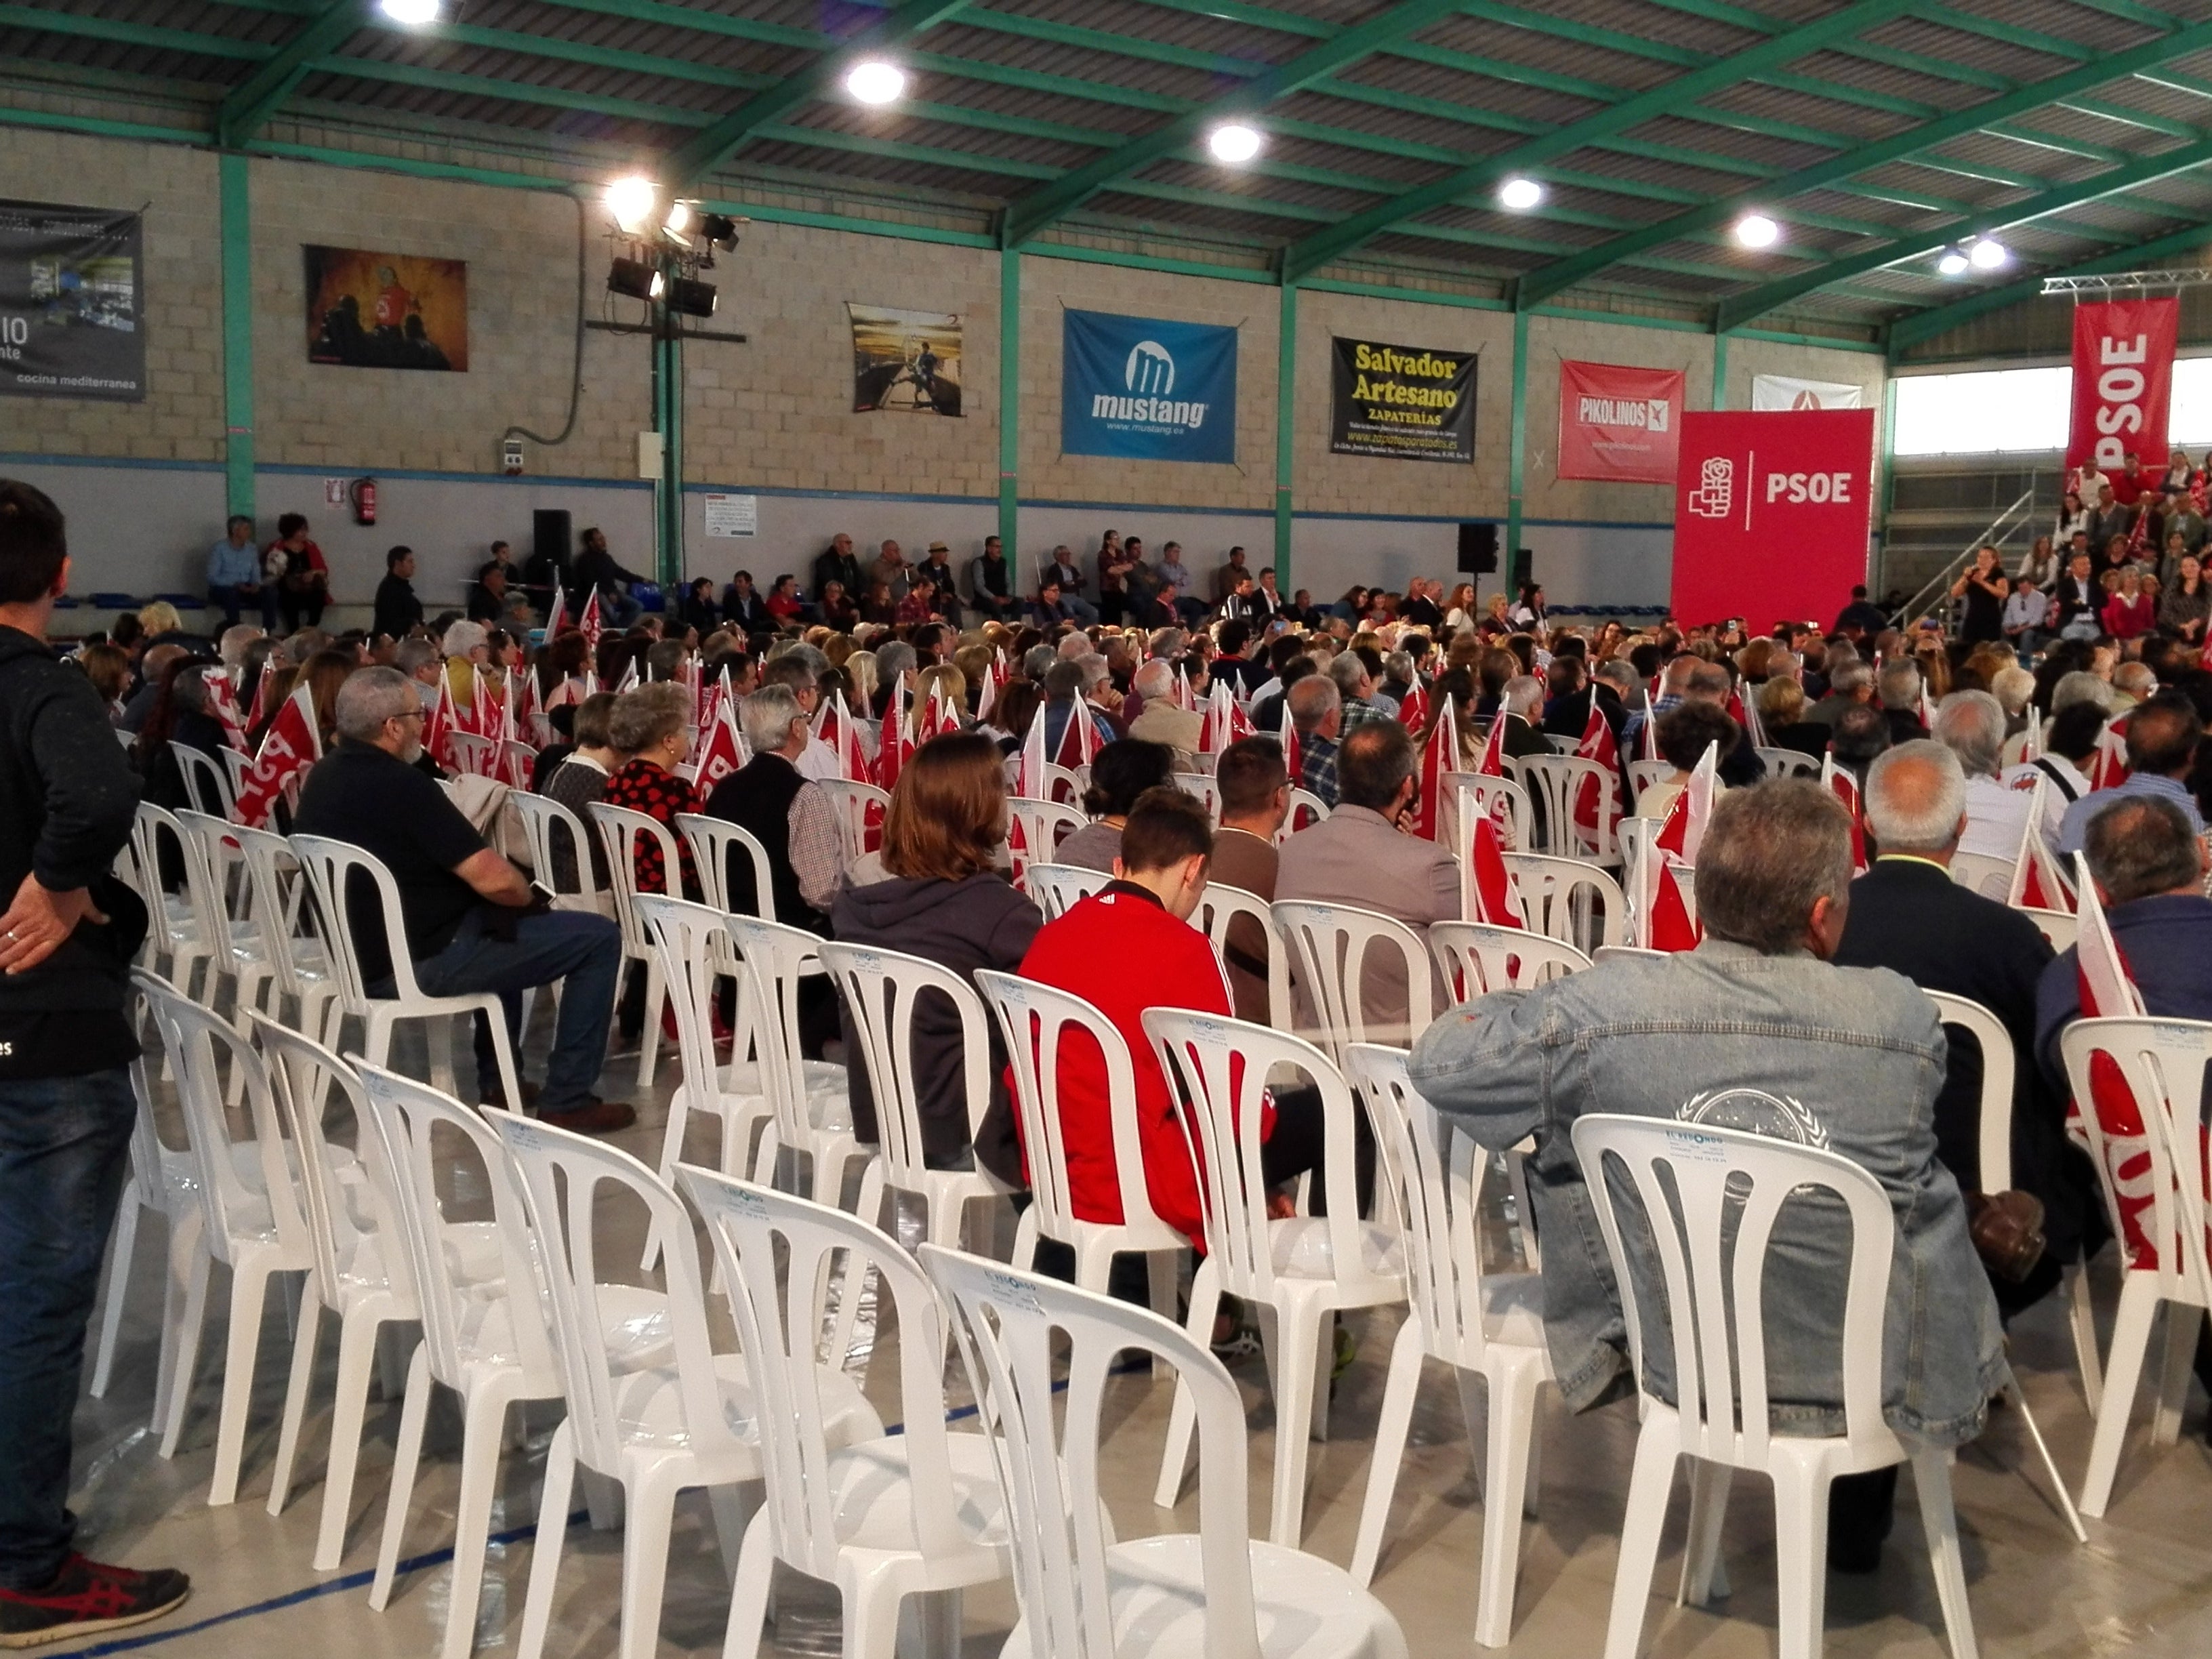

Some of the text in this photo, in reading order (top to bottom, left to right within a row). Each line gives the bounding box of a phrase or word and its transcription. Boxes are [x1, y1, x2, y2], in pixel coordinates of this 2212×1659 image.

[1356, 344, 1457, 379] Salvador
[17, 373, 136, 390] cocina mediterranea
[1351, 374, 1458, 409] Artesano
[1091, 394, 1206, 429] mustang
[1580, 397, 1646, 427] PIKOLINOS
[2095, 333, 2148, 468] PSOE
[1106, 422, 1185, 436] www.mustang.es
[1368, 408, 1442, 426] ZAPATERÍAS
[1766, 472, 1852, 504] PSOE
